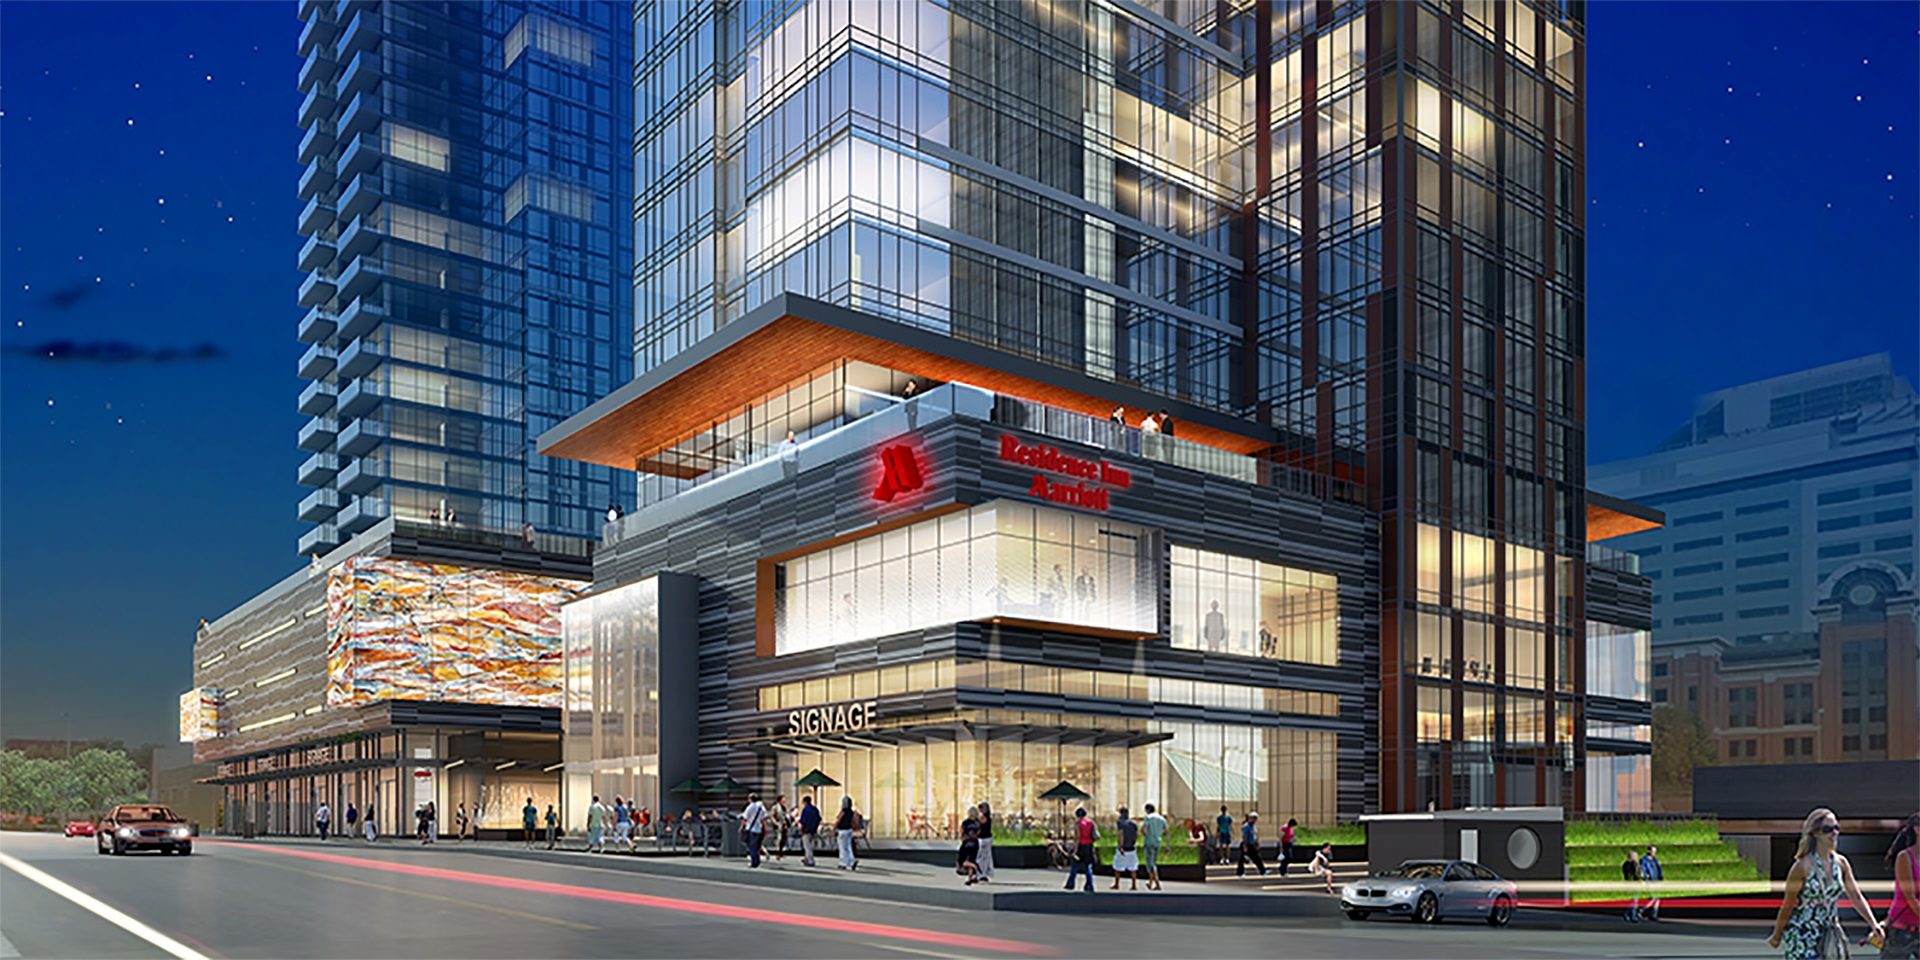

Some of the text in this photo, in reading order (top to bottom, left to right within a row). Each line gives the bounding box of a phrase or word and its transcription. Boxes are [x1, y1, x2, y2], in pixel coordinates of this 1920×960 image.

[1000, 434, 1130, 488] Residence Inn
[1028, 475, 1108, 510] Marriott
[788, 701, 877, 736] SIGNAGE
